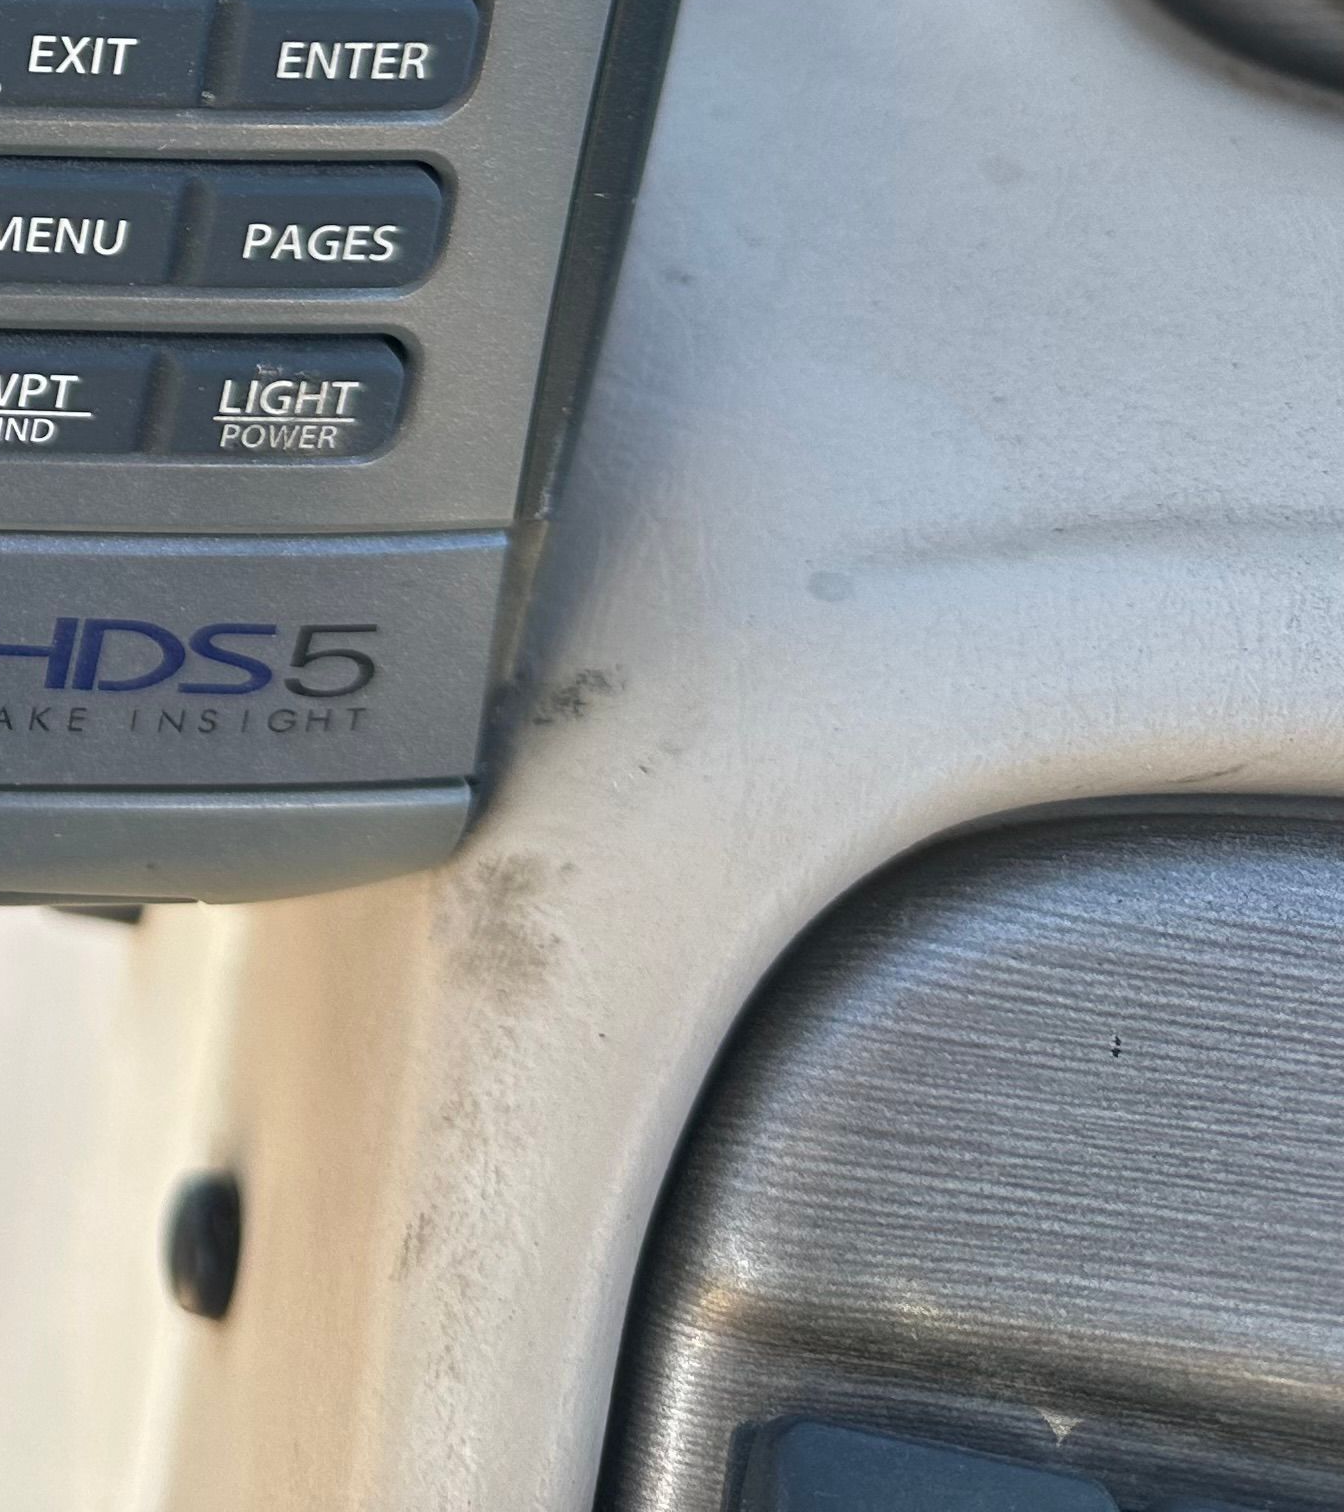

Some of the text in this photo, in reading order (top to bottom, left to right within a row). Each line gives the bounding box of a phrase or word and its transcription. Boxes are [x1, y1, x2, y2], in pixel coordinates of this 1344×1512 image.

[27, 35, 138, 75] EXIT
[275, 41, 432, 81] ENTER
[242, 223, 400, 261] PAGES
[217, 379, 359, 416] LIGHT
[219, 423, 337, 450] POWER
[129, 707, 369, 734] INSIGHT
